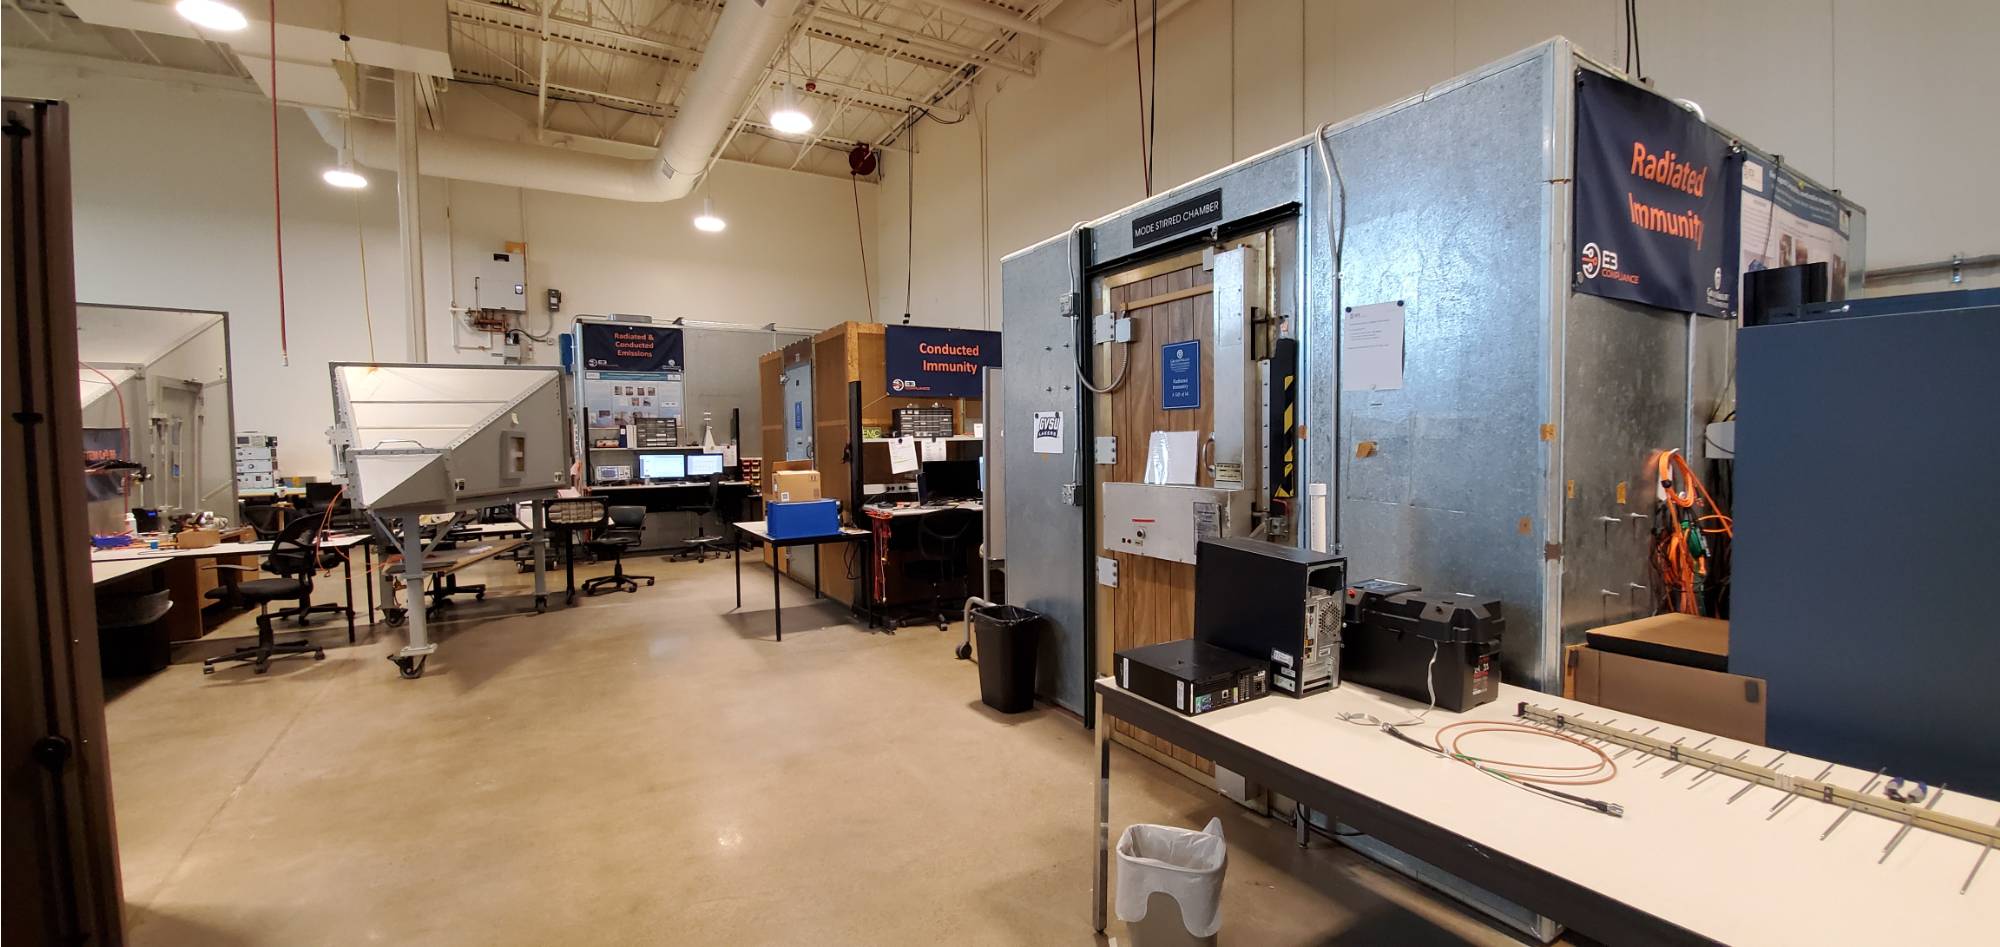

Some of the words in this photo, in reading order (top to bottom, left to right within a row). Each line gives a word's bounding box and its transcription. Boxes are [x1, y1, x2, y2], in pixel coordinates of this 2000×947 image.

[1631, 141, 1709, 197] Radiated
[1134, 223, 1154, 237] MODE
[1155, 214, 1182, 231] STIRRED
[1182, 200, 1219, 221] CHAMBER
[1628, 192, 1704, 250] Immunity
[1601, 250, 1618, 270] E3
[1601, 268, 1641, 285] COMPLIANCE
[615, 341, 654, 349] Conducted
[919, 343, 979, 356] Conducted
[923, 360, 978, 375] Immunity
[1039, 416, 1060, 430] GVSU
